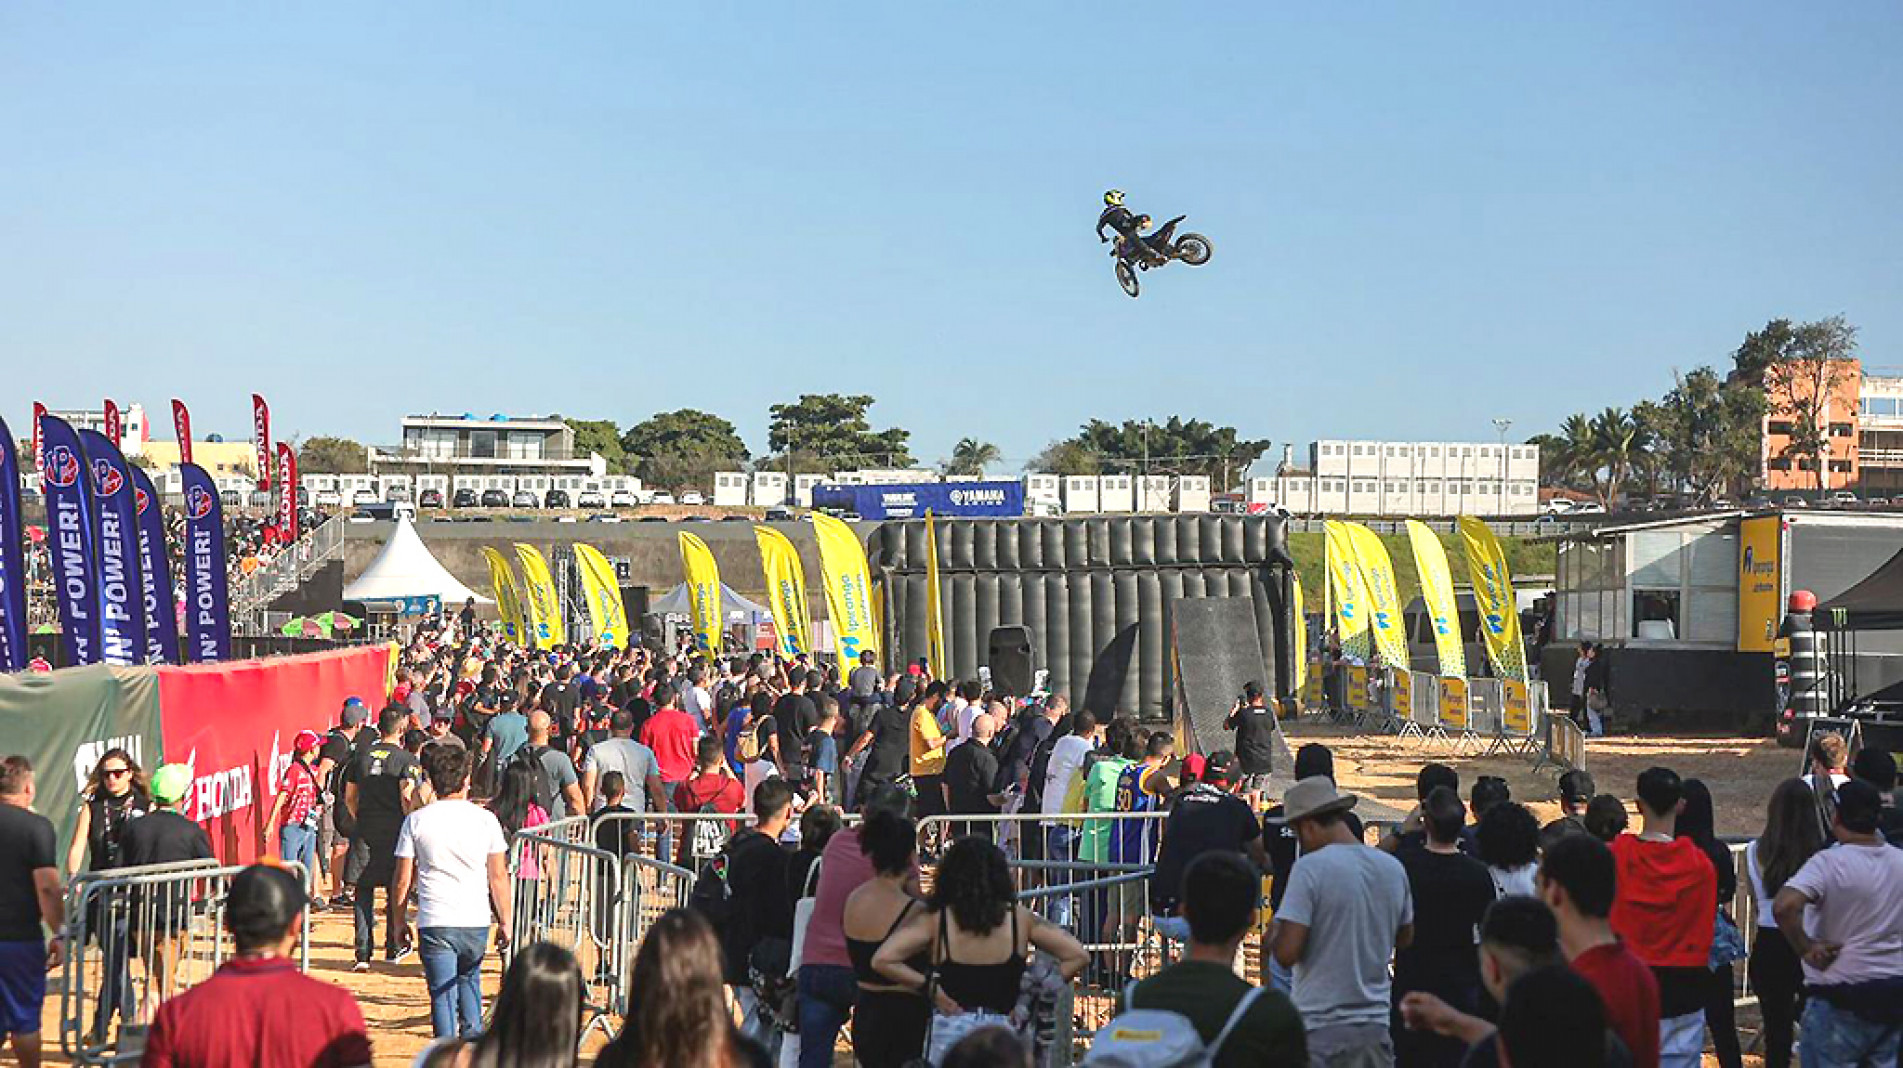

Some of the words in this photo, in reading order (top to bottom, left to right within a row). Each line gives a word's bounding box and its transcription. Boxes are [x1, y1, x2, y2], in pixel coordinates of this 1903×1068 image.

[280, 450, 291, 531] HONDA
[102, 511, 131, 621] POWER!
[194, 530, 216, 625] POWER!
[196, 764, 252, 821] HONDA
